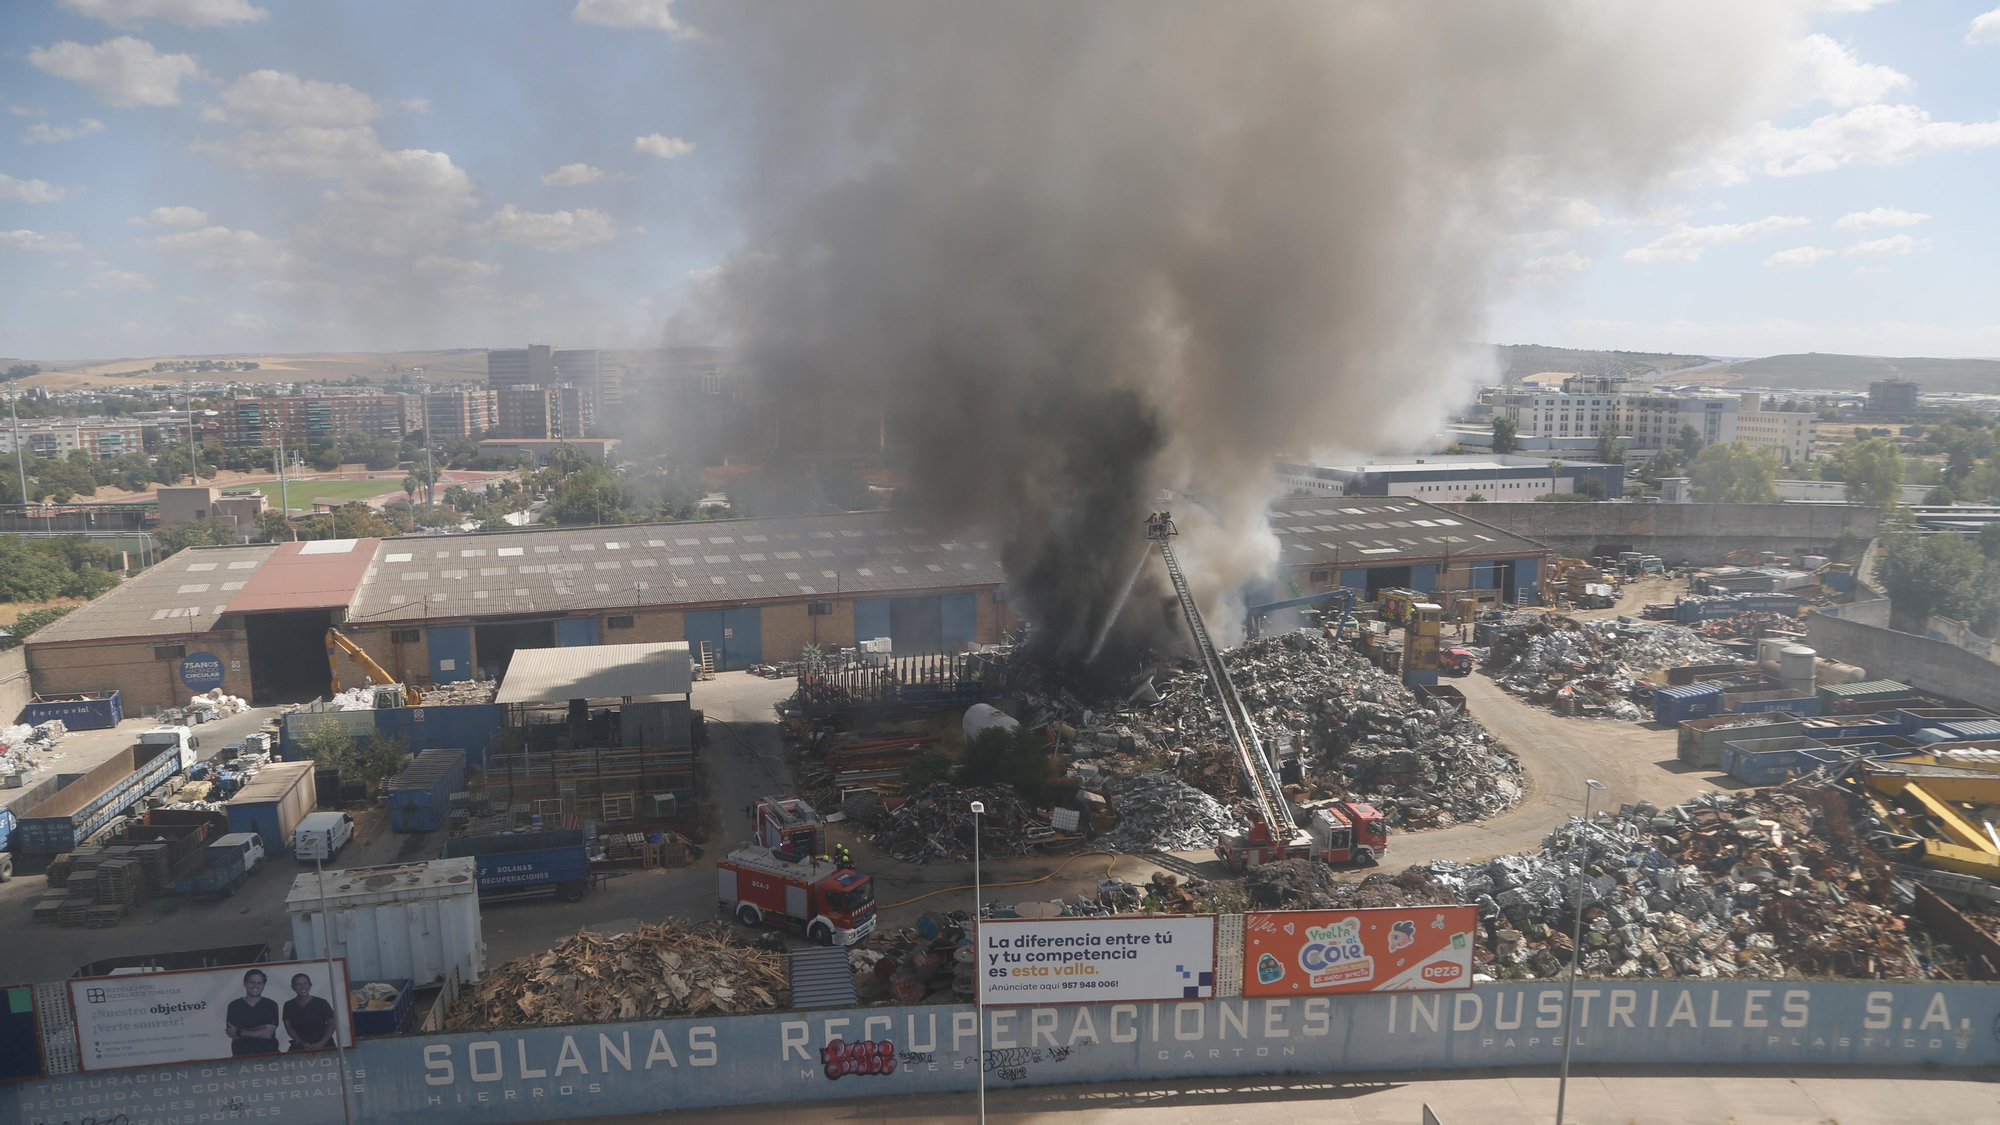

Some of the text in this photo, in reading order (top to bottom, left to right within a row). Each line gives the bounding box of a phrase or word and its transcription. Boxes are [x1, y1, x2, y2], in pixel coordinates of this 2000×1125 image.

[32, 706, 90, 717] ferrovial
[497, 864, 533, 873] SOLANAS
[481, 872, 549, 885] RECUPERACIONES
[989, 931, 1172, 949] La diferencia entre tú
[1310, 925, 1351, 941] Vuelta
[1346, 935, 1357, 945] al
[989, 947, 1137, 965] y tu competencia
[1302, 943, 1361, 971] Cole
[989, 962, 1099, 978] es esta valla.
[988, 982, 1038, 993] ¡Anúnciate
[1039, 981, 1060, 992] aquí
[1079, 981, 1097, 989] 948
[92, 1001, 207, 1020] ¿Nuestro objetivo?
[93, 1022, 131, 1035] ¡Verte
[423, 1025, 718, 1086] SOLANAS
[781, 997, 1330, 1061] RECUPERACIONES
[1388, 990, 1810, 1034] INDUSTRIALES
[1864, 991, 1971, 1030] S.A.
[37, 1056, 347, 1095] TRITURACION DE ARCHIVOS
[428, 1036, 1969, 1105] HIERROS MLES CARTON PAPEL PLASTICOS
[22, 1069, 366, 1112] RECOGIDA EN CONTENEDORES
[30, 1100, 196, 1125] DESMONTAJES
